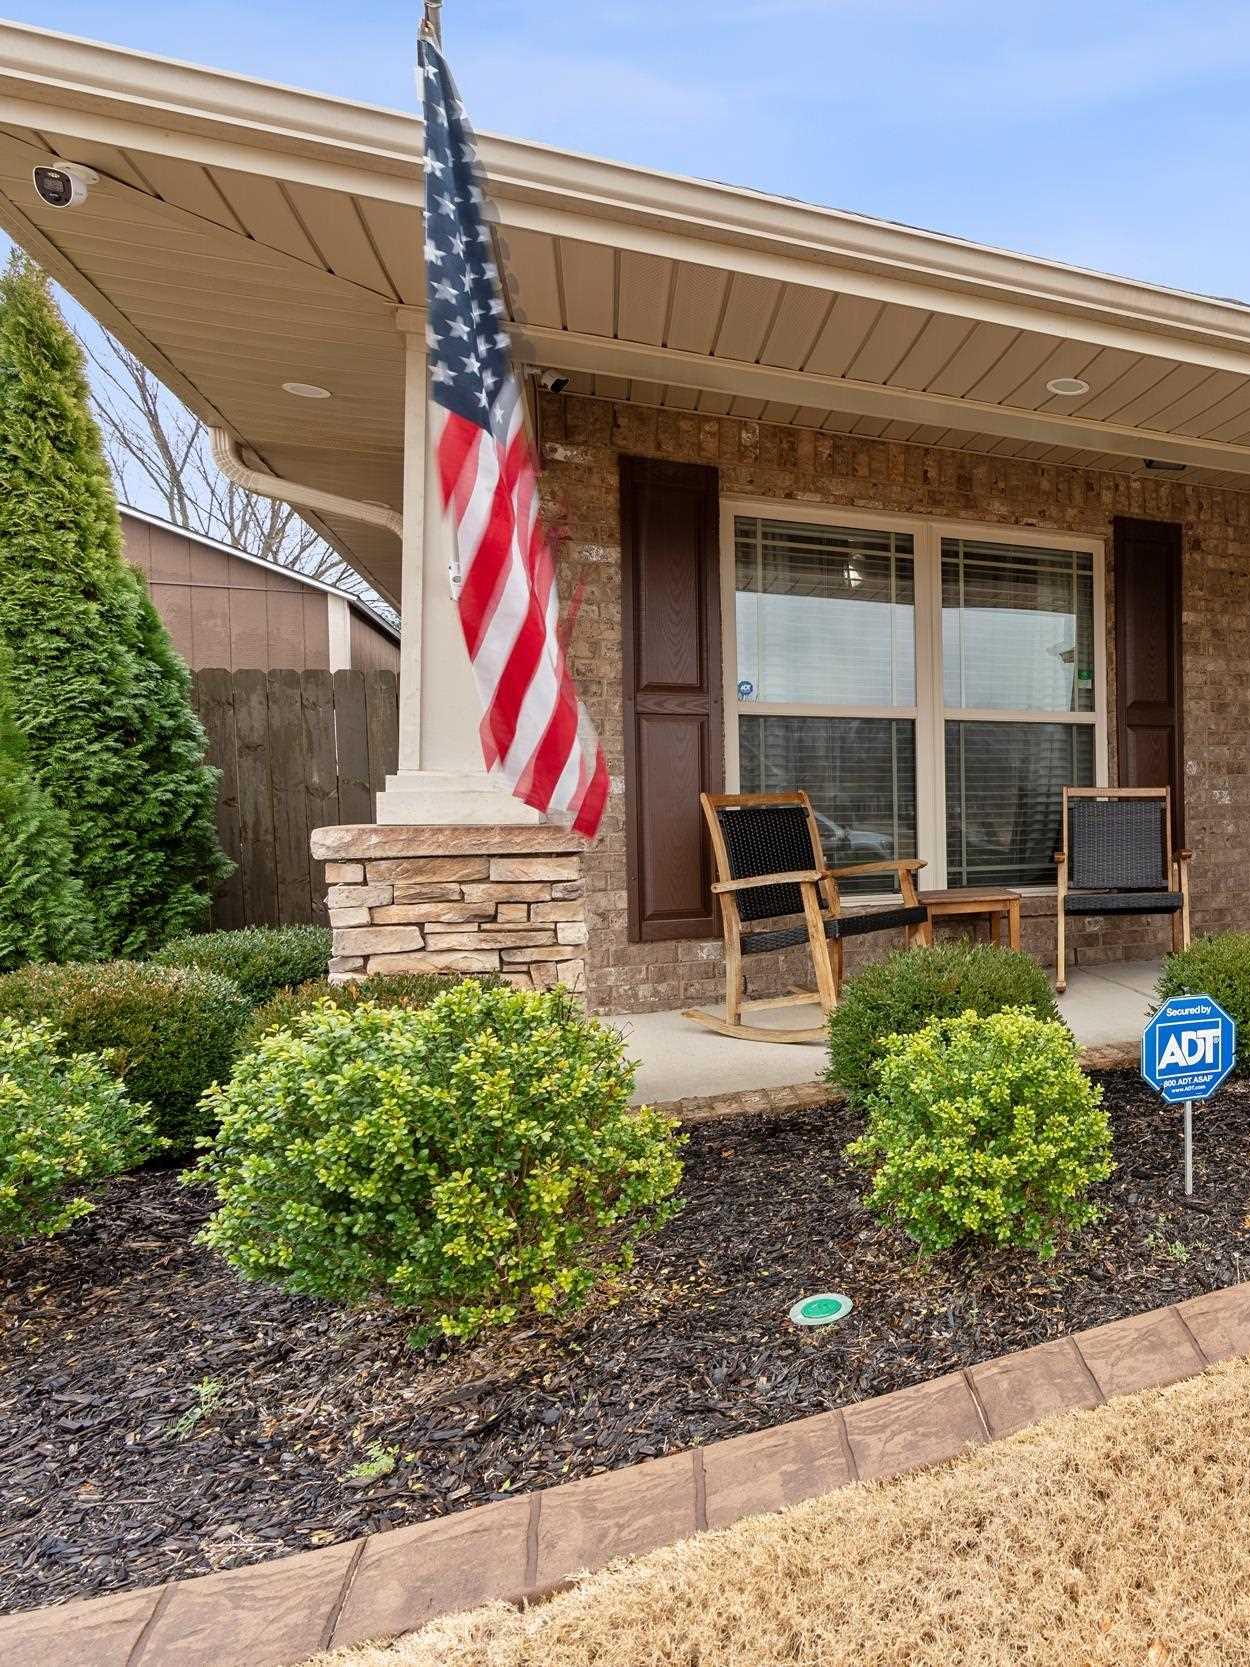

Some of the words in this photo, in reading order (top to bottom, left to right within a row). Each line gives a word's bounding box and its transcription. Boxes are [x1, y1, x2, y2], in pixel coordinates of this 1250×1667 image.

[1166, 1005, 1200, 1017] Secured
[1201, 1004, 1212, 1015] by
[1158, 1028, 1220, 1070] ADT
